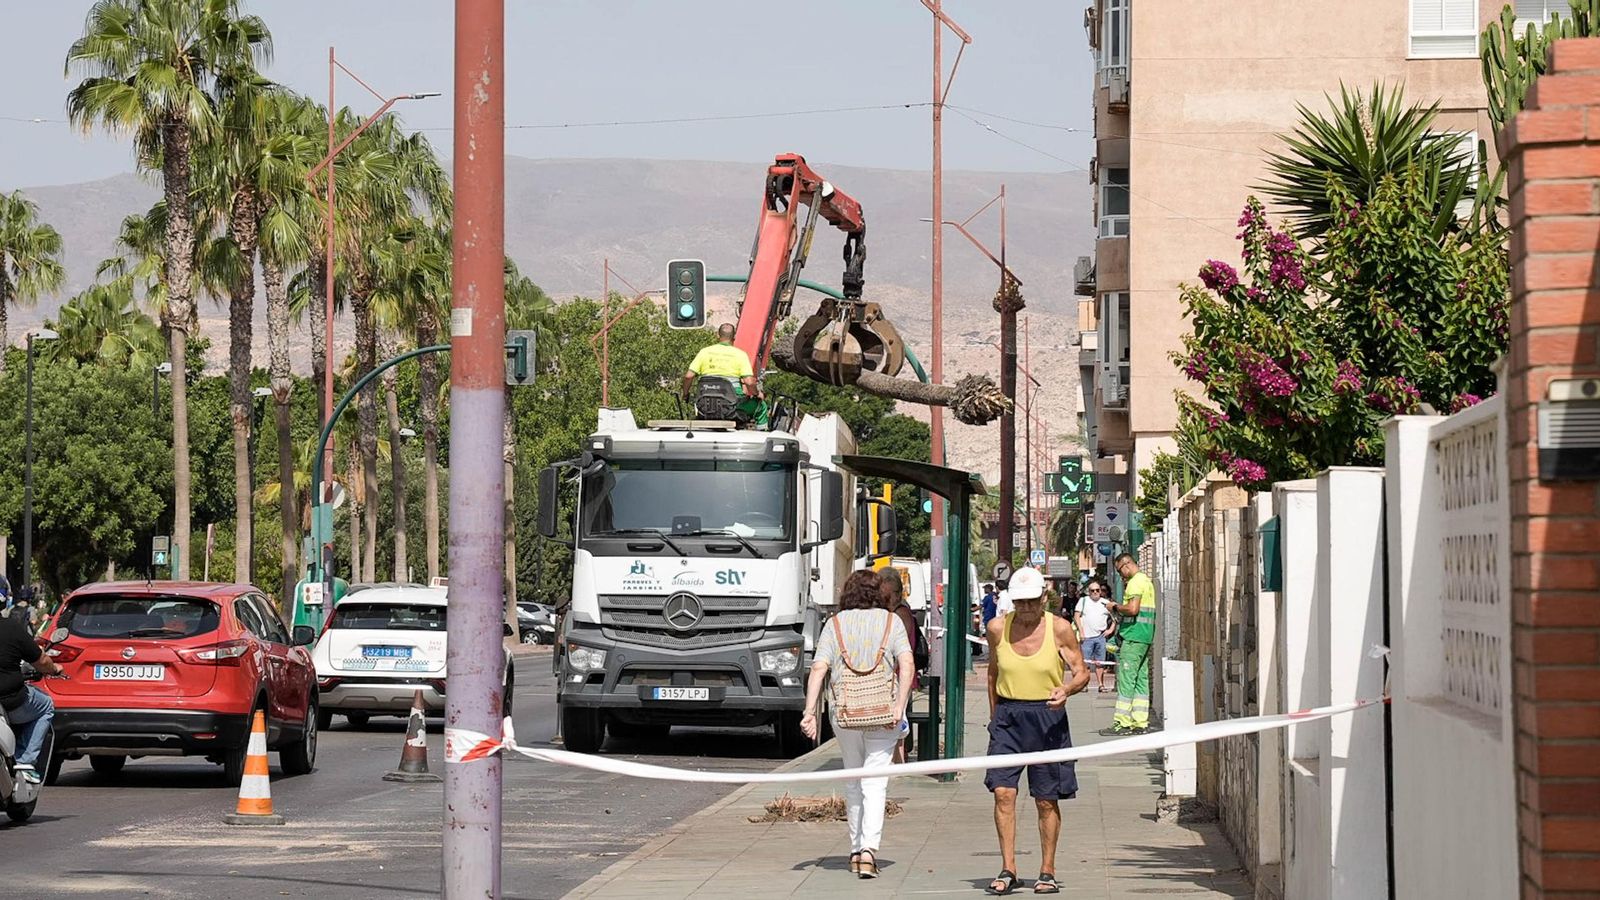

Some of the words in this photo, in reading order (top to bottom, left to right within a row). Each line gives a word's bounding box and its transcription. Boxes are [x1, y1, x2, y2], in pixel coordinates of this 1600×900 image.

[671, 577, 705, 586] albaida
[715, 569, 746, 585] stv
[103, 666, 134, 678] 9950
[138, 666, 162, 678] JJJ
[661, 689, 685, 698] 3157
[688, 689, 707, 699] LPJ
